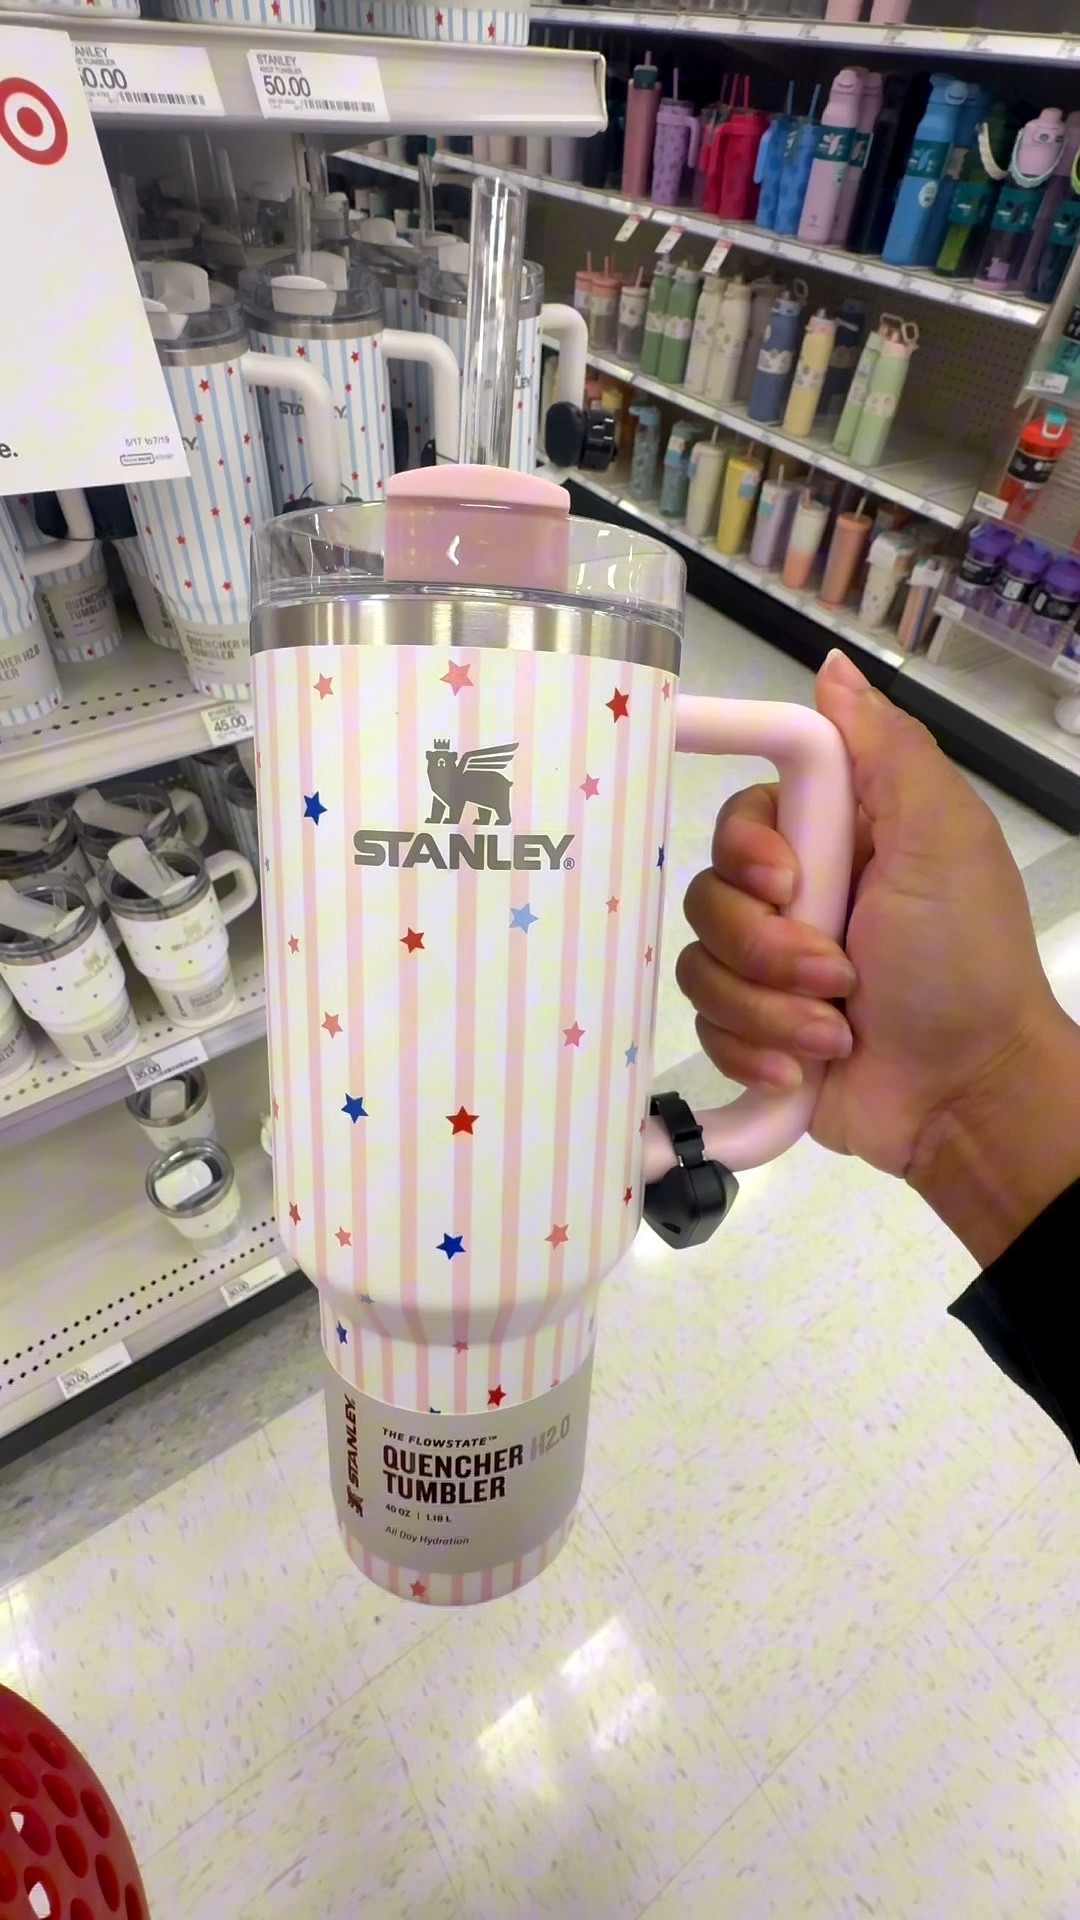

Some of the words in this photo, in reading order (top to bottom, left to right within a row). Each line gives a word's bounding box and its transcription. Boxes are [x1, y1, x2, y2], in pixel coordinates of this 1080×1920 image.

[75, 46, 108, 58] ANLEY
[256, 54, 297, 66] STANLEY
[263, 75, 312, 97] 50.00
[278, 401, 348, 419] STAY
[214, 713, 247, 732] 45.00
[382, 1427, 404, 1441] THE
[382, 1444, 524, 1479] QUENCHER
[382, 1469, 506, 1505] TUMBLER
[385, 1504, 397, 1513] 40
[398, 1508, 411, 1518] OZ
[385, 1525, 398, 1536] All
[400, 1530, 418, 1543] Day
[420, 1534, 469, 1546] Hydration
